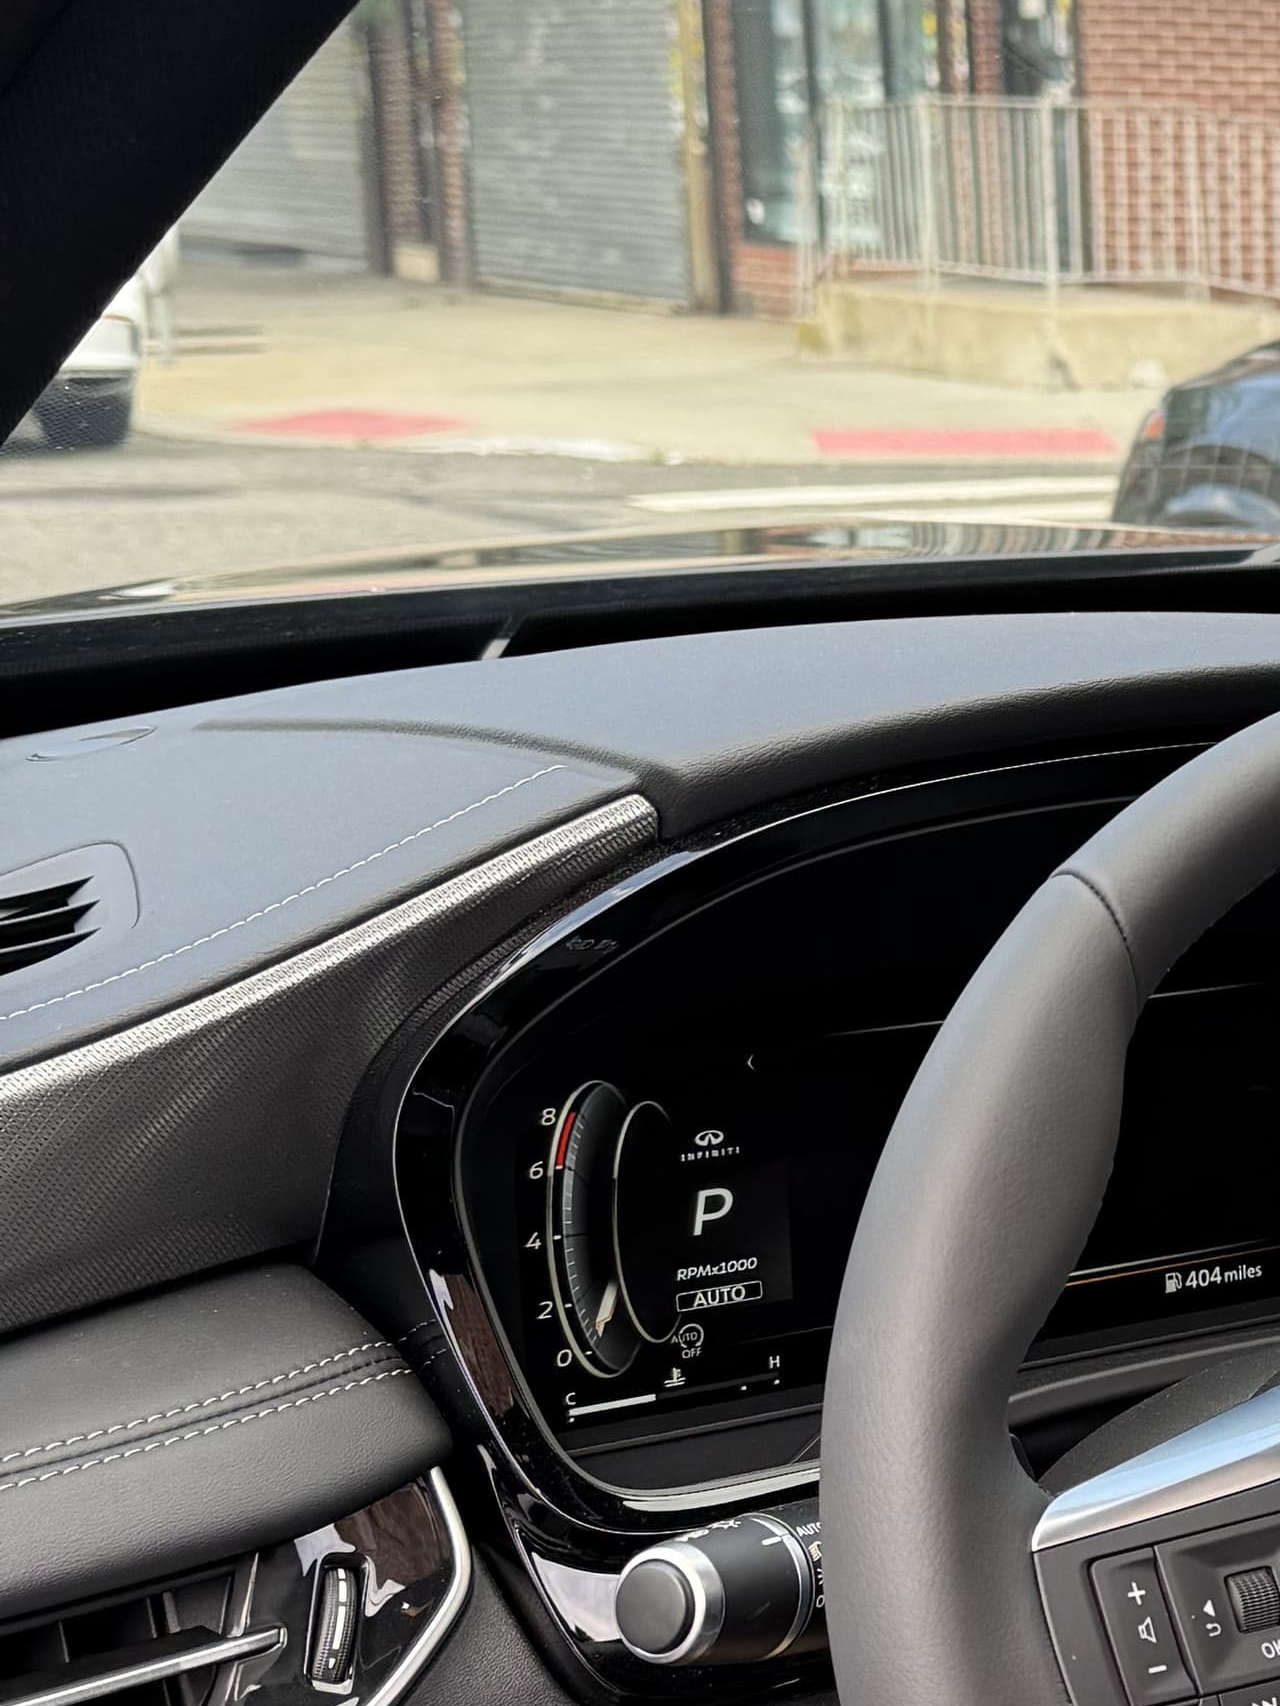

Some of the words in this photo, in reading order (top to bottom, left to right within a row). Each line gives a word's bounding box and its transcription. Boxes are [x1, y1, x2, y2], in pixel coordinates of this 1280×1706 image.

[542, 1108, 556, 1126] 8
[530, 1162, 543, 1179] 6
[693, 1188, 733, 1236] P
[527, 1232, 541, 1250] 4
[677, 1257, 758, 1281] RPMx1000
[694, 1285, 746, 1308] AUTO
[537, 1301, 553, 1319] 2
[557, 1349, 573, 1367] 0
[682, 1348, 702, 1359] OFF
[770, 1356, 780, 1367] H
[566, 1393, 576, 1405] C
